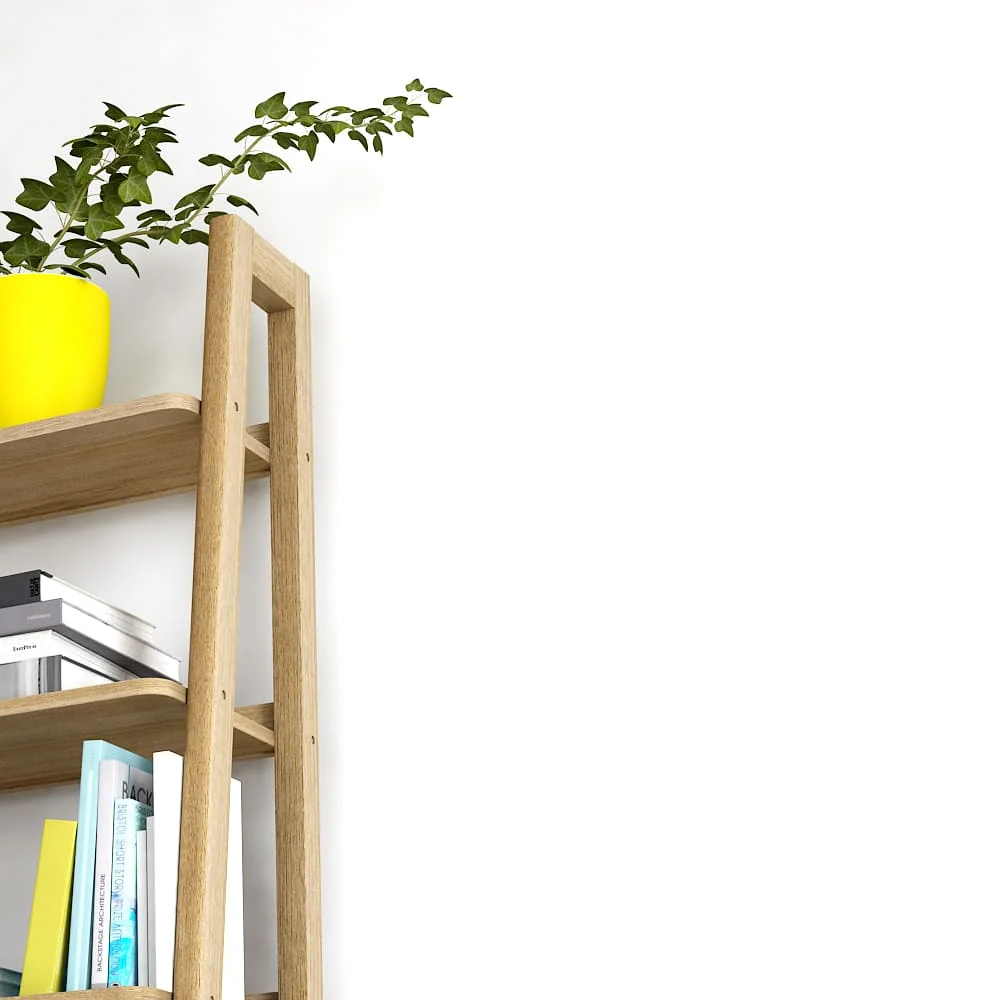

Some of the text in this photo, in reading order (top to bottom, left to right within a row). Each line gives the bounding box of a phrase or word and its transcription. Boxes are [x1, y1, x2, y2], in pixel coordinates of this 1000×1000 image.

[115, 840, 126, 866] SHORT
[96, 874, 106, 972] BACKSTAGE ARCHITECTURE
